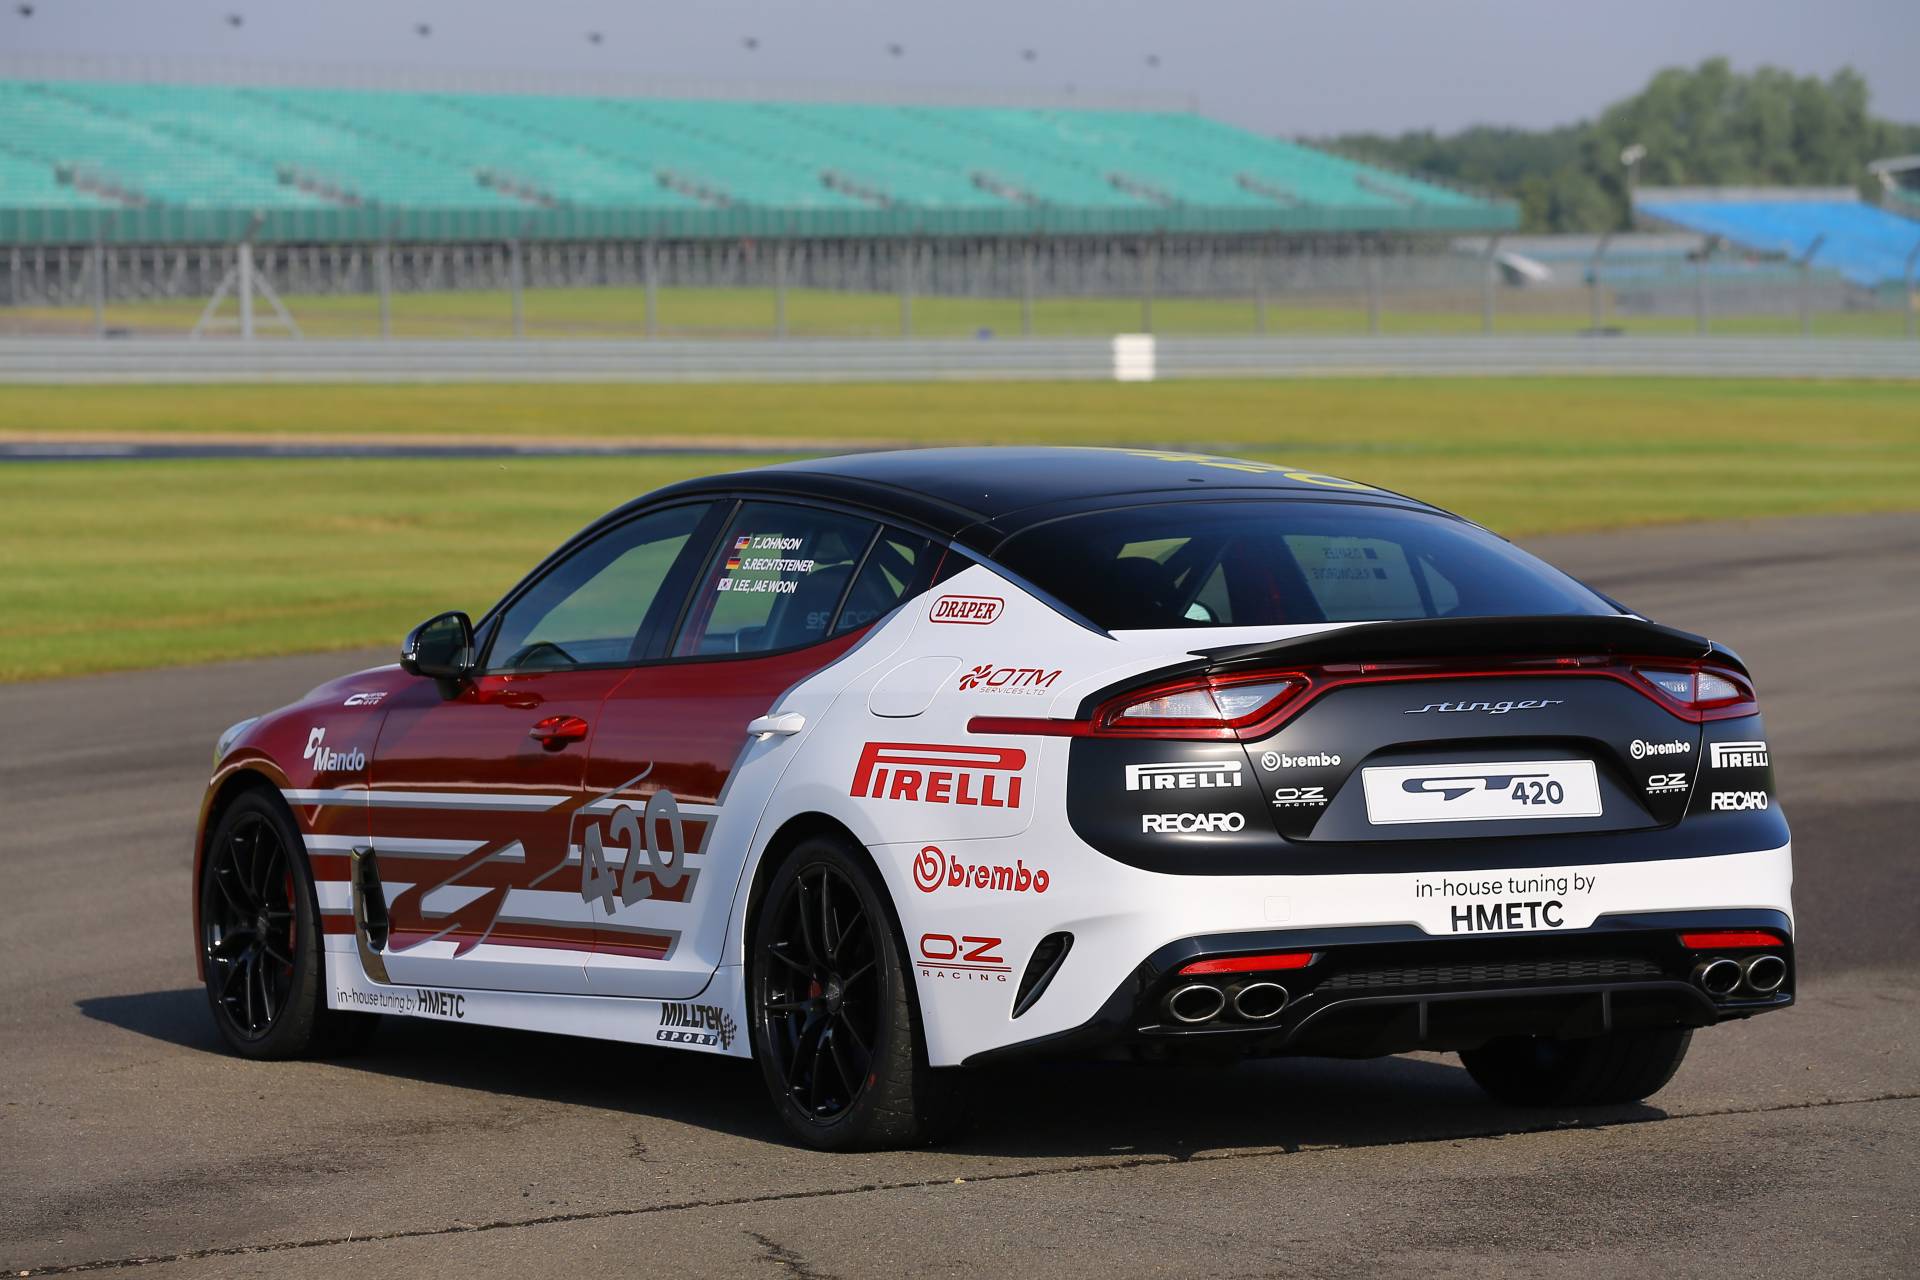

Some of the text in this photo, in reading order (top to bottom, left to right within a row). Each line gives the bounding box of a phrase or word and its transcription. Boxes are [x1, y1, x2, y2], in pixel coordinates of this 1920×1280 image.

[752, 537, 802, 550] T.JOHNSON
[743, 558, 814, 573] S.RECHTSTEINER
[935, 601, 996, 619] DRAPER
[986, 668, 1063, 687] OTM
[979, 686, 1046, 696] SERVICES LTD
[1404, 700, 1565, 714] stinger
[313, 746, 365, 771] Mando
[1645, 740, 1691, 756] brembo
[1710, 741, 1769, 768] PIRELLI
[1281, 752, 1341, 768] brembo
[850, 742, 1027, 808] PIRELLI
[1125, 760, 1242, 791] PIRELLI
[1511, 780, 1564, 805] 420
[1711, 791, 1768, 810] RECARO
[1142, 812, 1245, 833] RECARO
[581, 790, 684, 916] 420
[948, 855, 1050, 893] brembo
[1416, 872, 1595, 897] in-house tuning by
[1451, 900, 1564, 932] HMETC
[922, 970, 1006, 982] RACING
[337, 987, 416, 1014] in-house tuning by
[416, 988, 465, 1019] HMETC
[659, 1031, 717, 1044] SPORT
